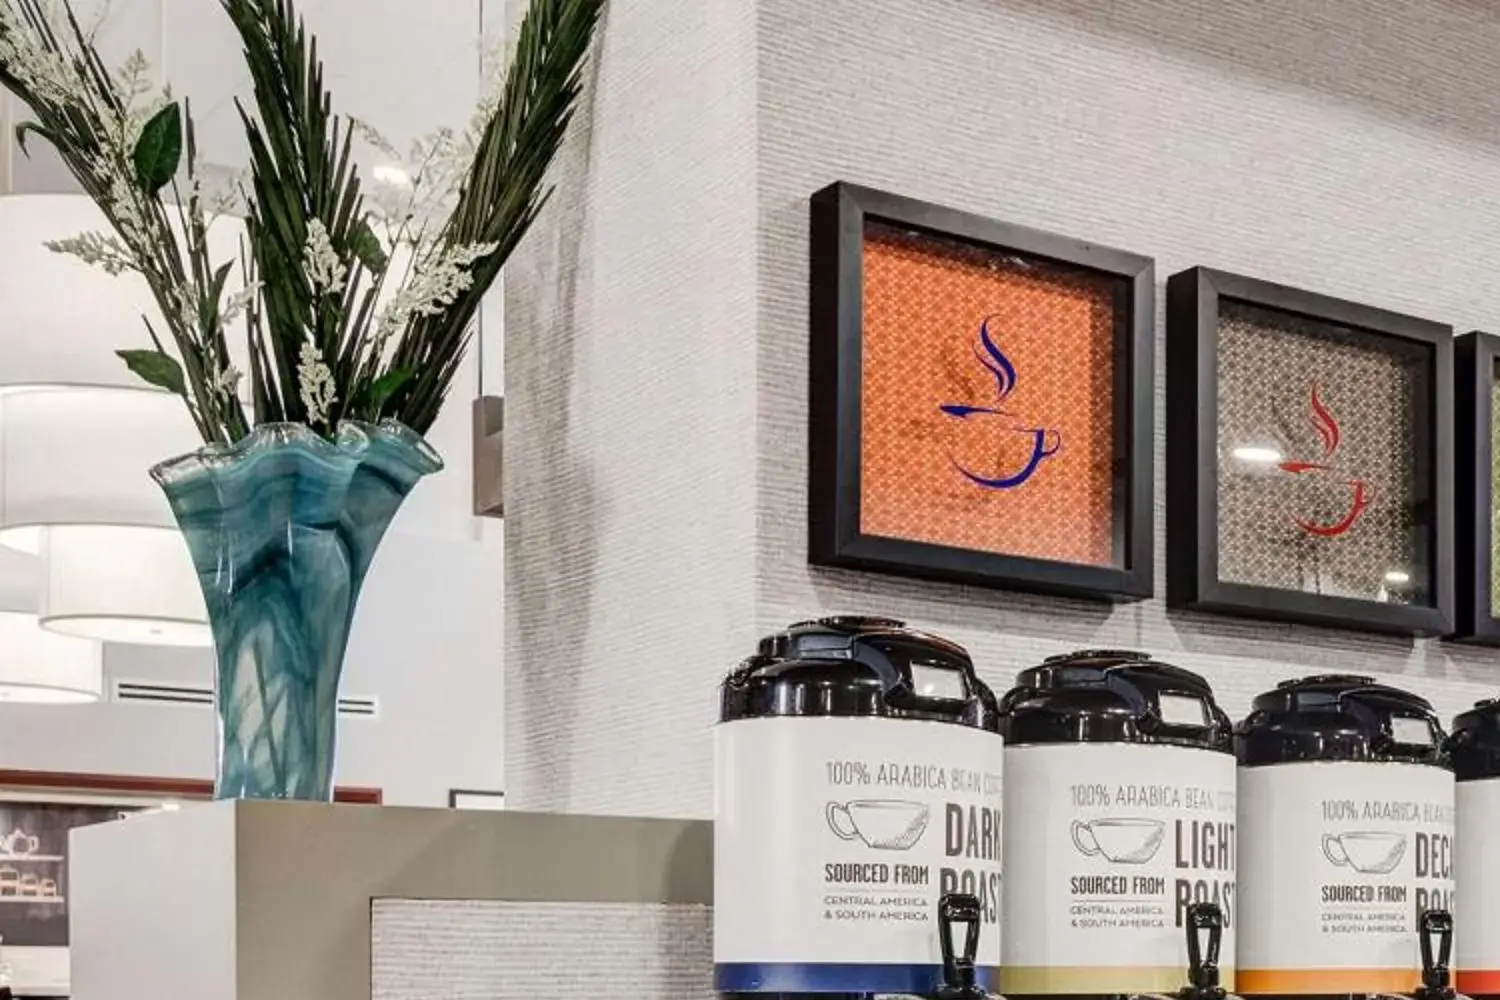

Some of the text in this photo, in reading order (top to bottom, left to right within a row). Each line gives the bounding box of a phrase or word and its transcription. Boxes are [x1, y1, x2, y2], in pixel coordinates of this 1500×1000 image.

[826, 761, 871, 786] 100%
[876, 763, 947, 790] ARABICA
[1071, 783, 1111, 807] 100%
[1115, 784, 1181, 808] ARABICA
[1322, 800, 1359, 821] 100%
[1362, 801, 1421, 822] ARABICA
[825, 863, 930, 885] SOURCED FROM
[1071, 876, 1166, 895] SOURCED FROM
[1321, 885, 1407, 903] SOURCED FROM
[824, 895, 929, 908] CENTRAL AMERICA
[1070, 905, 1164, 916] CENTRAL AMERICA
[824, 909, 929, 921] & SOUTH AMERICA
[1079, 919, 1117, 928] SOUTH
[1119, 920, 1165, 928] AMERICA
